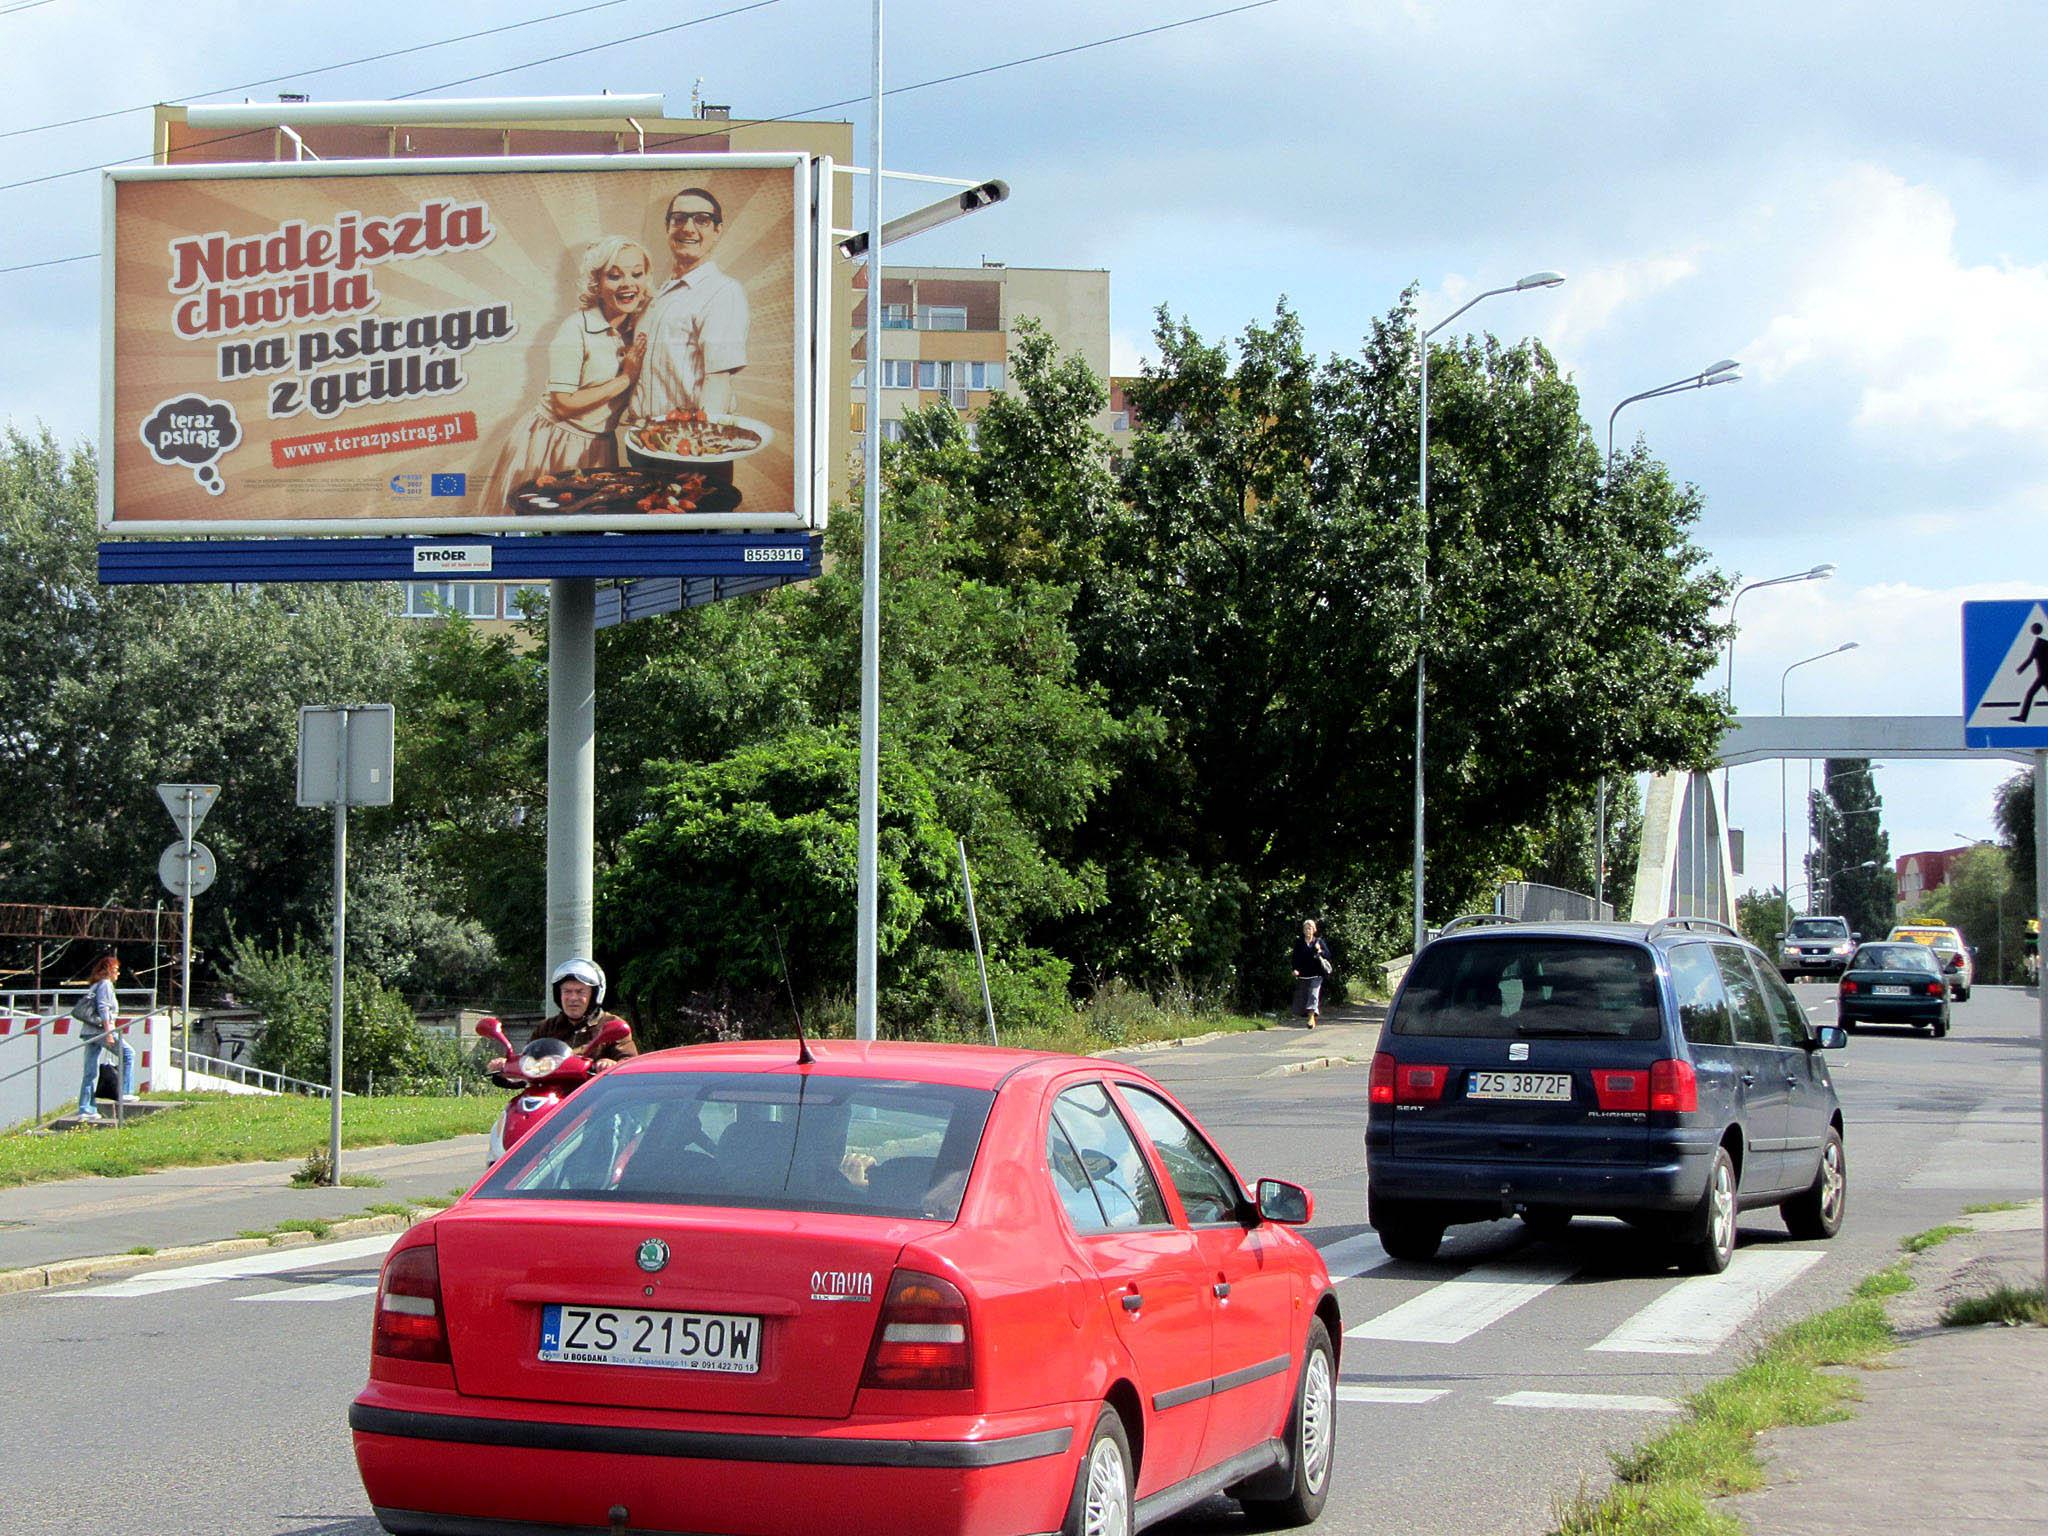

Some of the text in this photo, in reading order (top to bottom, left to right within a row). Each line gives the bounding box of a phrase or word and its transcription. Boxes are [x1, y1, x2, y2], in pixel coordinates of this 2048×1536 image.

[173, 201, 491, 290] Nadejszła
[177, 271, 375, 335] chwila
[221, 337, 292, 377] na
[272, 381, 303, 414] z
[170, 413, 214, 429] teraz
[160, 427, 221, 450] pstrąg
[282, 417, 463, 460] www.terazpstrag.pl
[746, 549, 802, 561] 8553916
[1479, 1074, 1506, 1093] ZS
[1511, 1075, 1569, 1094] 3872F
[810, 1270, 873, 1295] OCTAVIA
[544, 1333, 557, 1345] PL
[564, 1310, 753, 1360] ZS 2150W
[563, 1352, 569, 1361] U
[571, 1353, 608, 1363] BOGDANA
